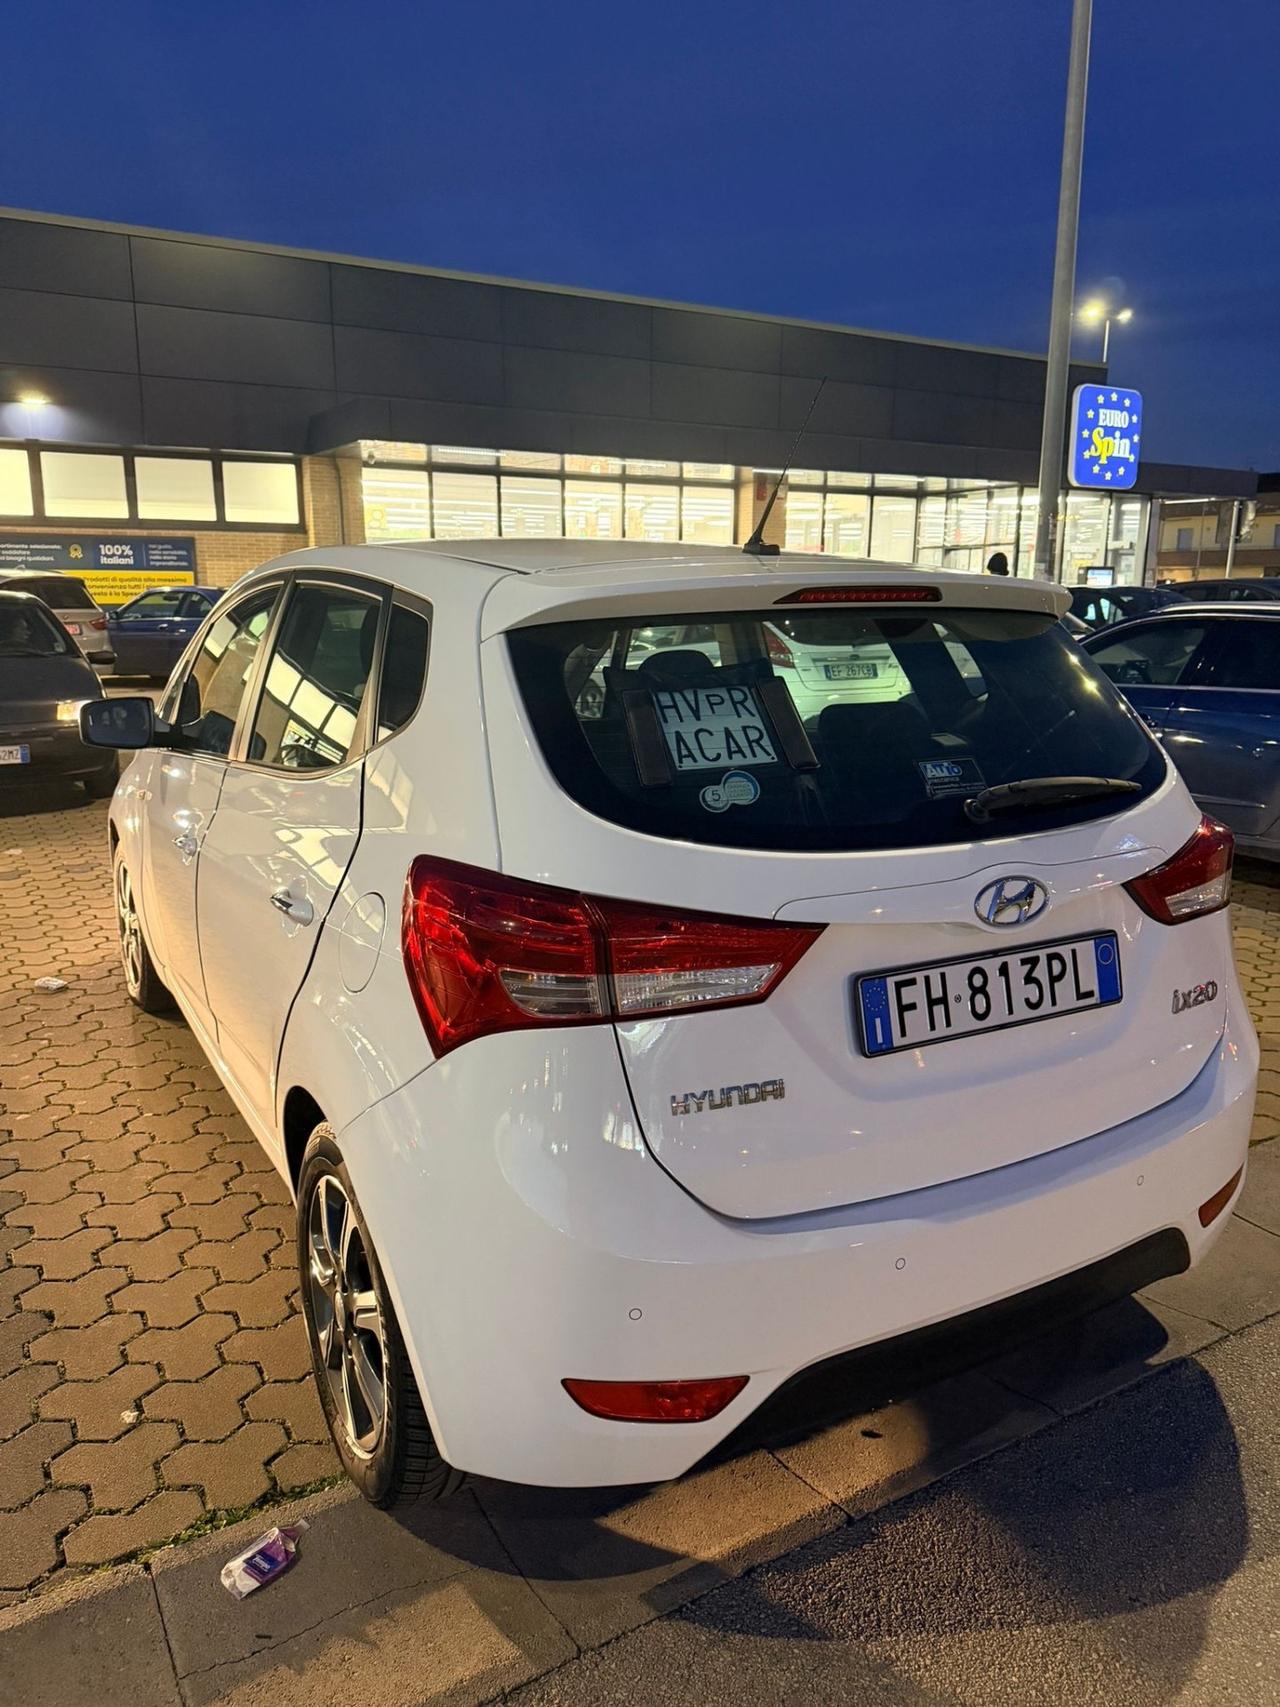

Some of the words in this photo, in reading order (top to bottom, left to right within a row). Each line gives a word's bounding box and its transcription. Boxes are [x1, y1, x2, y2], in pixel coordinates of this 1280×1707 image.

[1098, 408, 1130, 429] EURO
[1089, 427, 1131, 464] Spin
[99, 544, 133, 556] 100%
[100, 556, 134, 565] italiani
[673, 725, 772, 765] ACAR
[711, 789, 721, 802] 5
[894, 971, 952, 1038] FH
[967, 947, 1095, 1021] 813PL
[1171, 980, 1218, 1015] ix20
[670, 1078, 785, 1116] HYUNDAI
